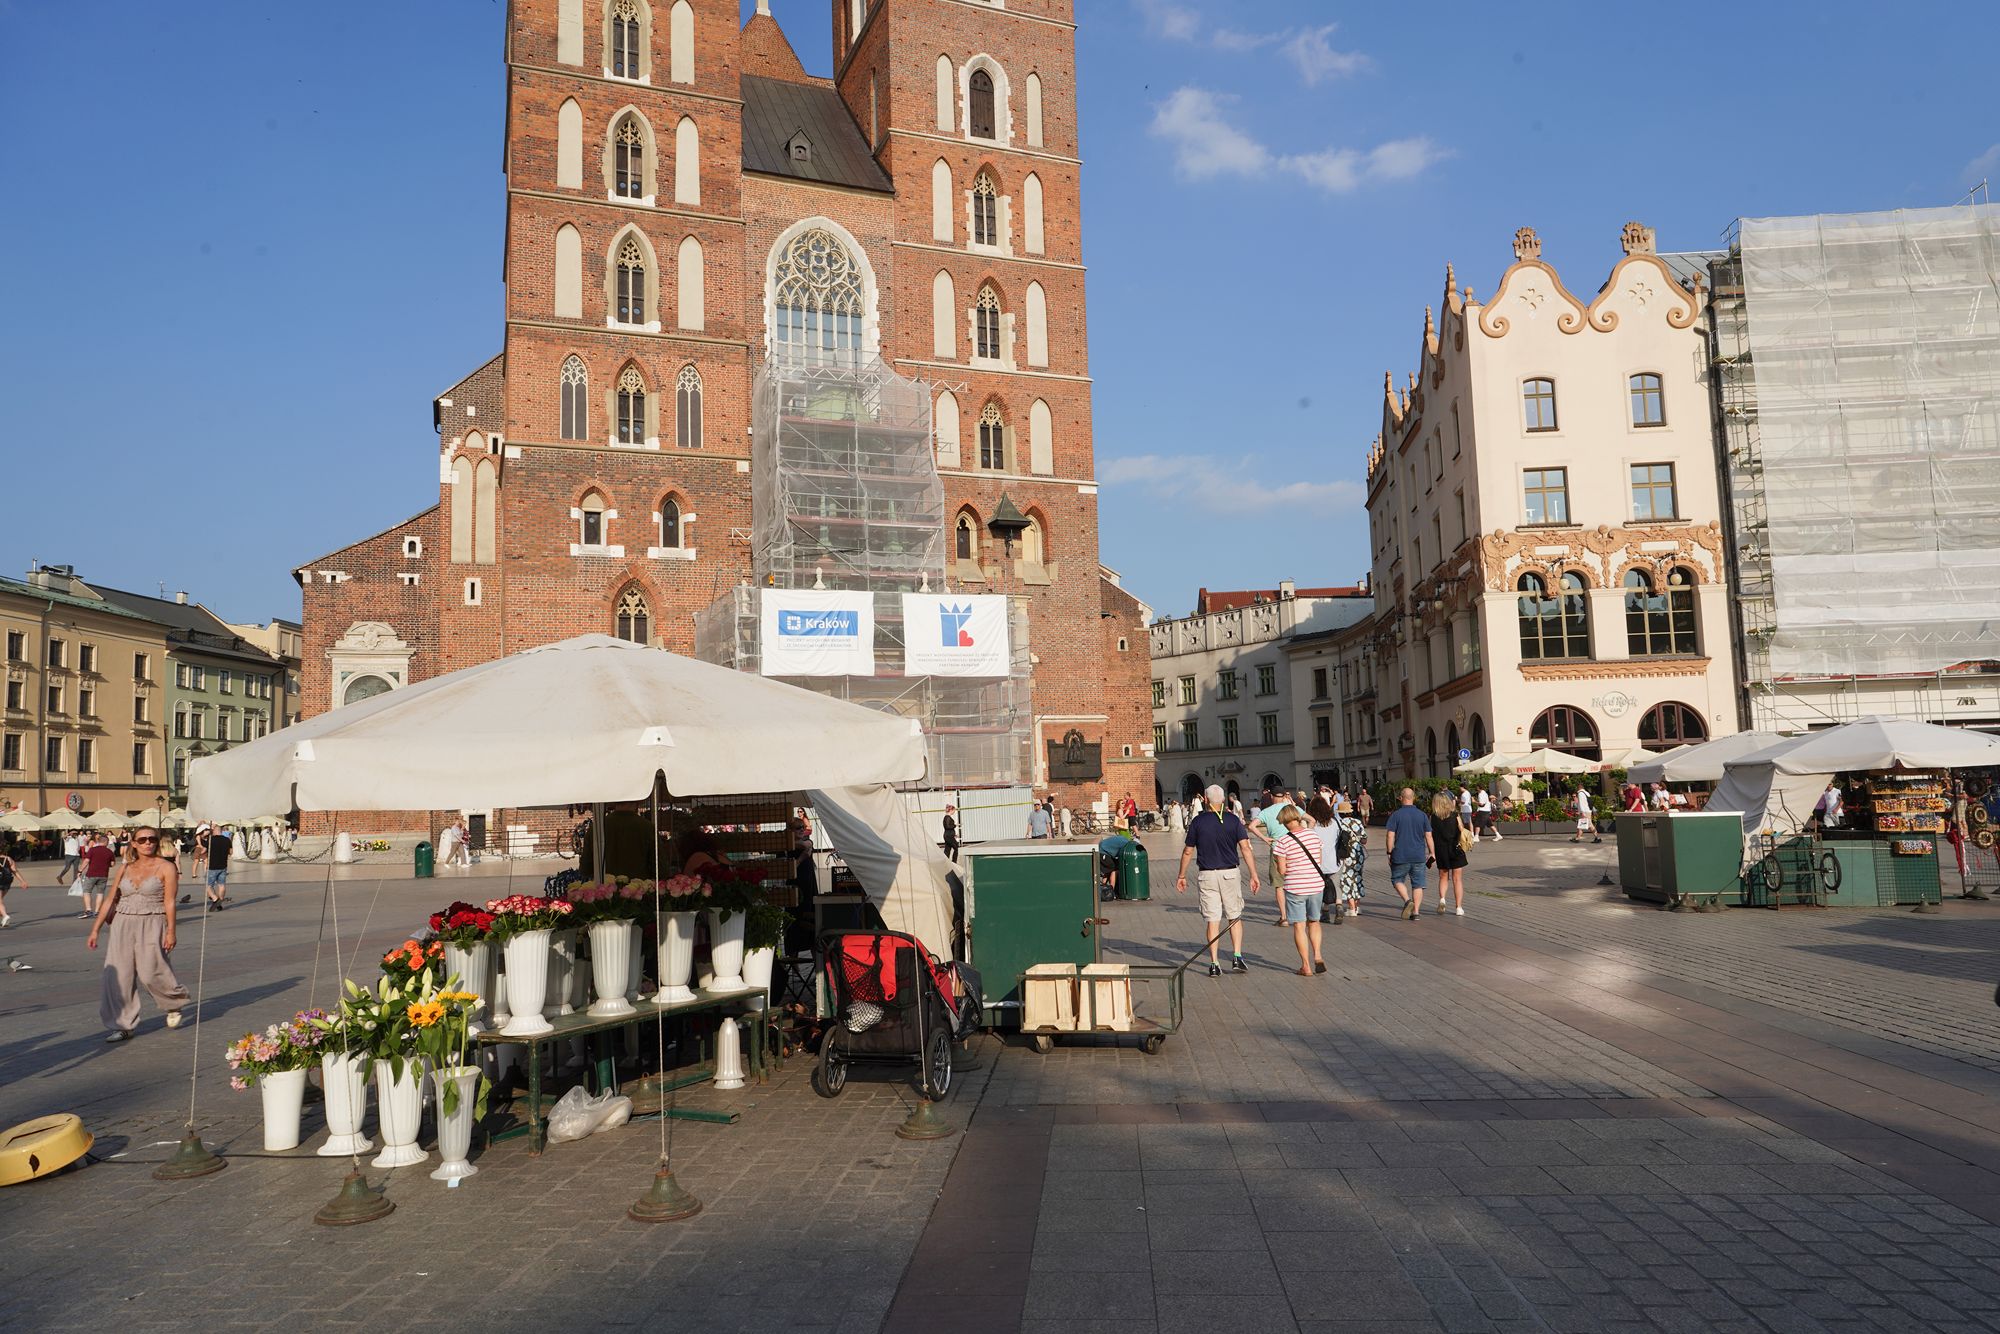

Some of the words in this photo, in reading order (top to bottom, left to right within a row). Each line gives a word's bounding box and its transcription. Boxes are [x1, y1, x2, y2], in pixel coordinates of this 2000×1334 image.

[805, 617, 850, 629] Kraków
[1592, 696, 1614, 708] Hard
[1616, 695, 1638, 707] Rock
[1956, 696, 1977, 706] ZARA
